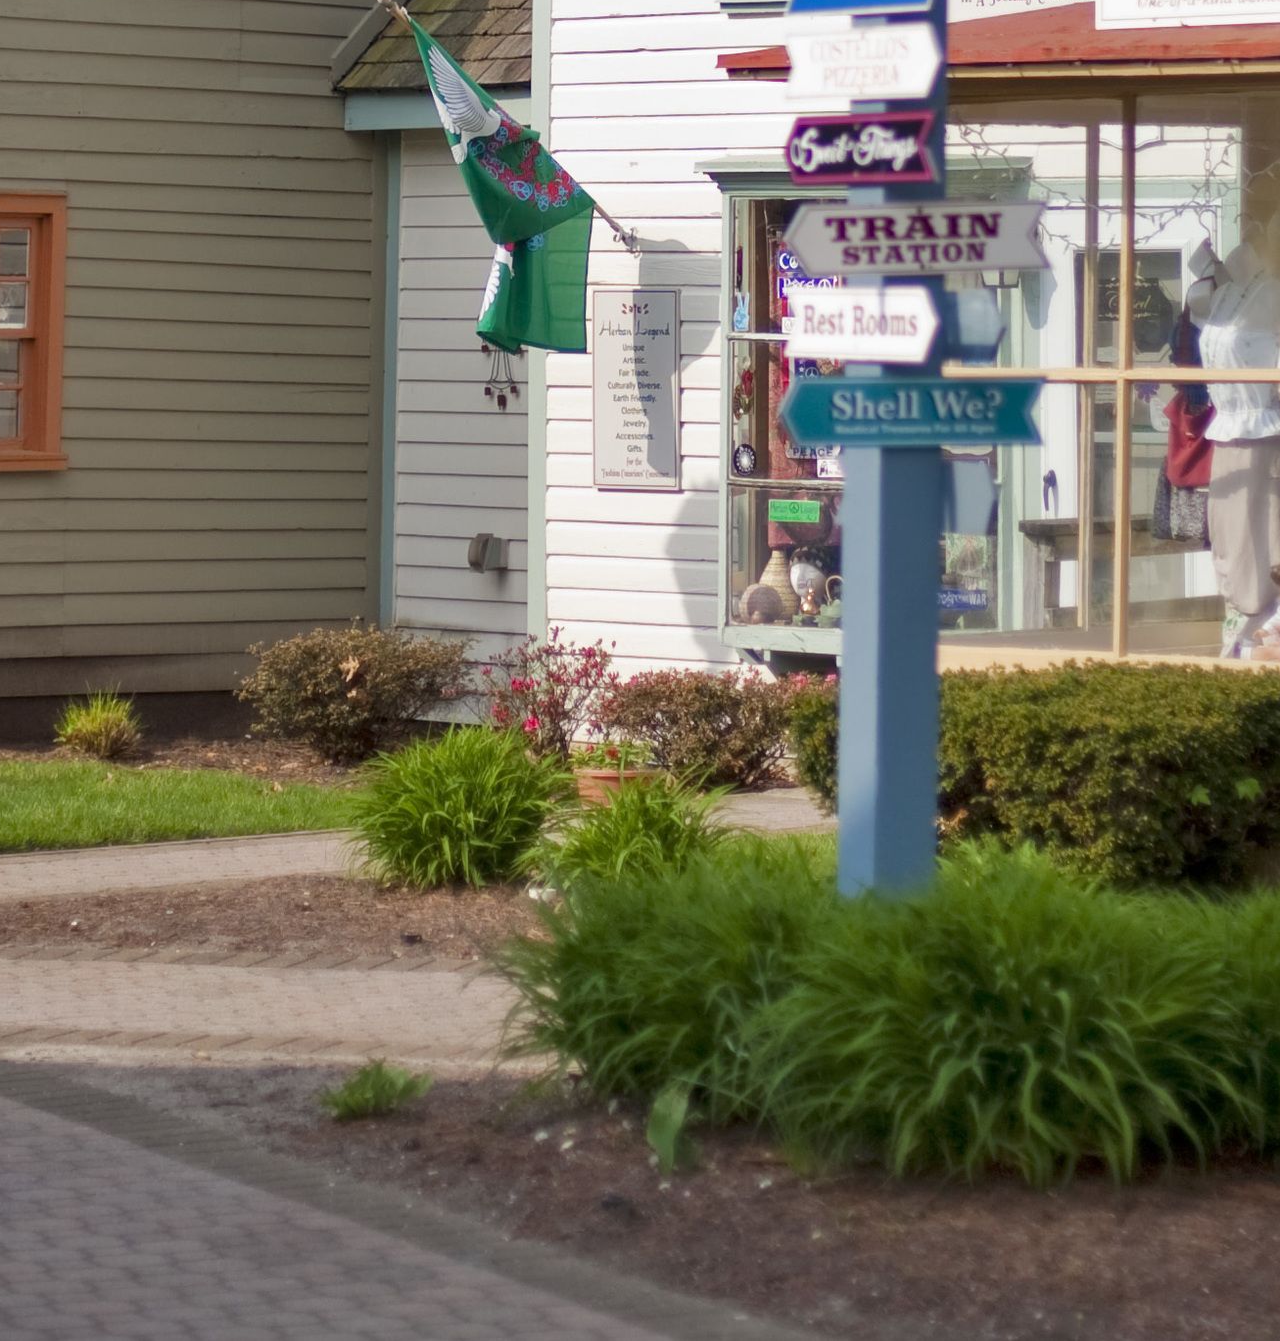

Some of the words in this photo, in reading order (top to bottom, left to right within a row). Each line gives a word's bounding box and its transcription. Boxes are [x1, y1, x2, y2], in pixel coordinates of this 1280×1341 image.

[824, 213, 1002, 242] TRAIN
[842, 242, 987, 266] STATION
[599, 319, 632, 336] Herban
[635, 319, 670, 340] Legend
[803, 305, 844, 336] Rest
[853, 305, 918, 336] Rooms
[831, 390, 920, 420] Shell
[931, 390, 1003, 420] We?
[792, 445, 834, 457] PEACE
